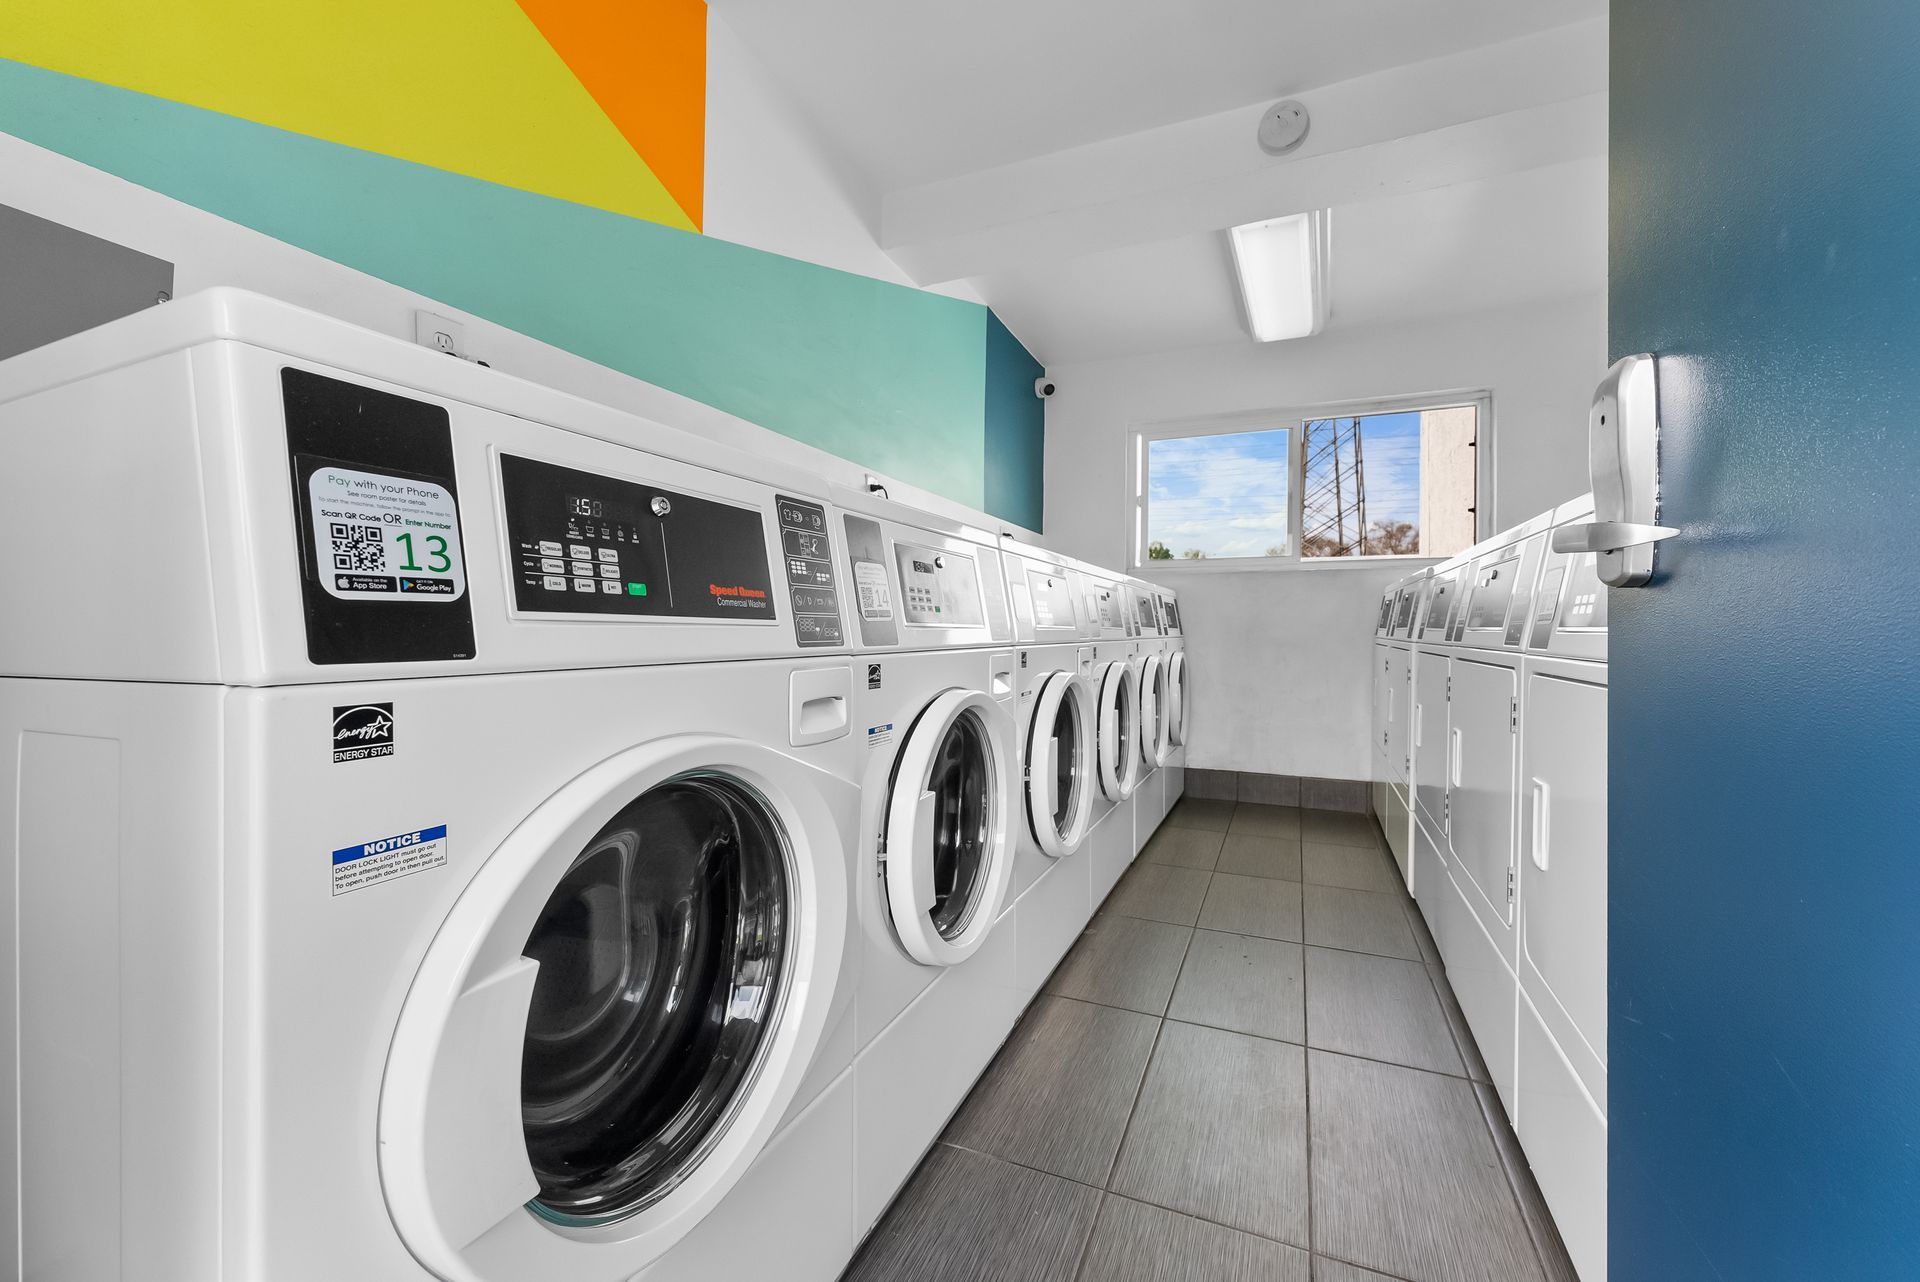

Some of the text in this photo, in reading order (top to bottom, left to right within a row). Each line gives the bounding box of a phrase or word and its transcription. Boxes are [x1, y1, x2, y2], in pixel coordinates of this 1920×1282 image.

[328, 475, 439, 499] Pay with your Phone
[379, 495, 398, 503] poster
[408, 499, 427, 507] details
[321, 510, 381, 522] Scan QR Code
[383, 513, 402, 525] OR
[405, 519, 452, 530] Enter Number
[396, 533, 452, 573] 13
[353, 582, 387, 590] App Store
[416, 584, 452, 593] Google Play
[709, 584, 765, 598] Speed Queen
[717, 597, 767, 608] Commercial Washer
[334, 746, 393, 762] ENERGY STAR
[363, 832, 421, 856] NOTICE
[335, 863, 357, 874] DOOR
[358, 858, 378, 868] LOCK
[380, 852, 399, 863] LIGHT
[401, 848, 417, 857] must
[418, 846, 426, 854] go
[335, 872, 357, 882] before
[359, 863, 394, 876] attempting
[402, 856, 418, 865] open
[345, 878, 365, 888] open,
[366, 872, 382, 883] push
[383, 868, 399, 877] door
[407, 861, 421, 870] then
[421, 857, 433, 866] pull
